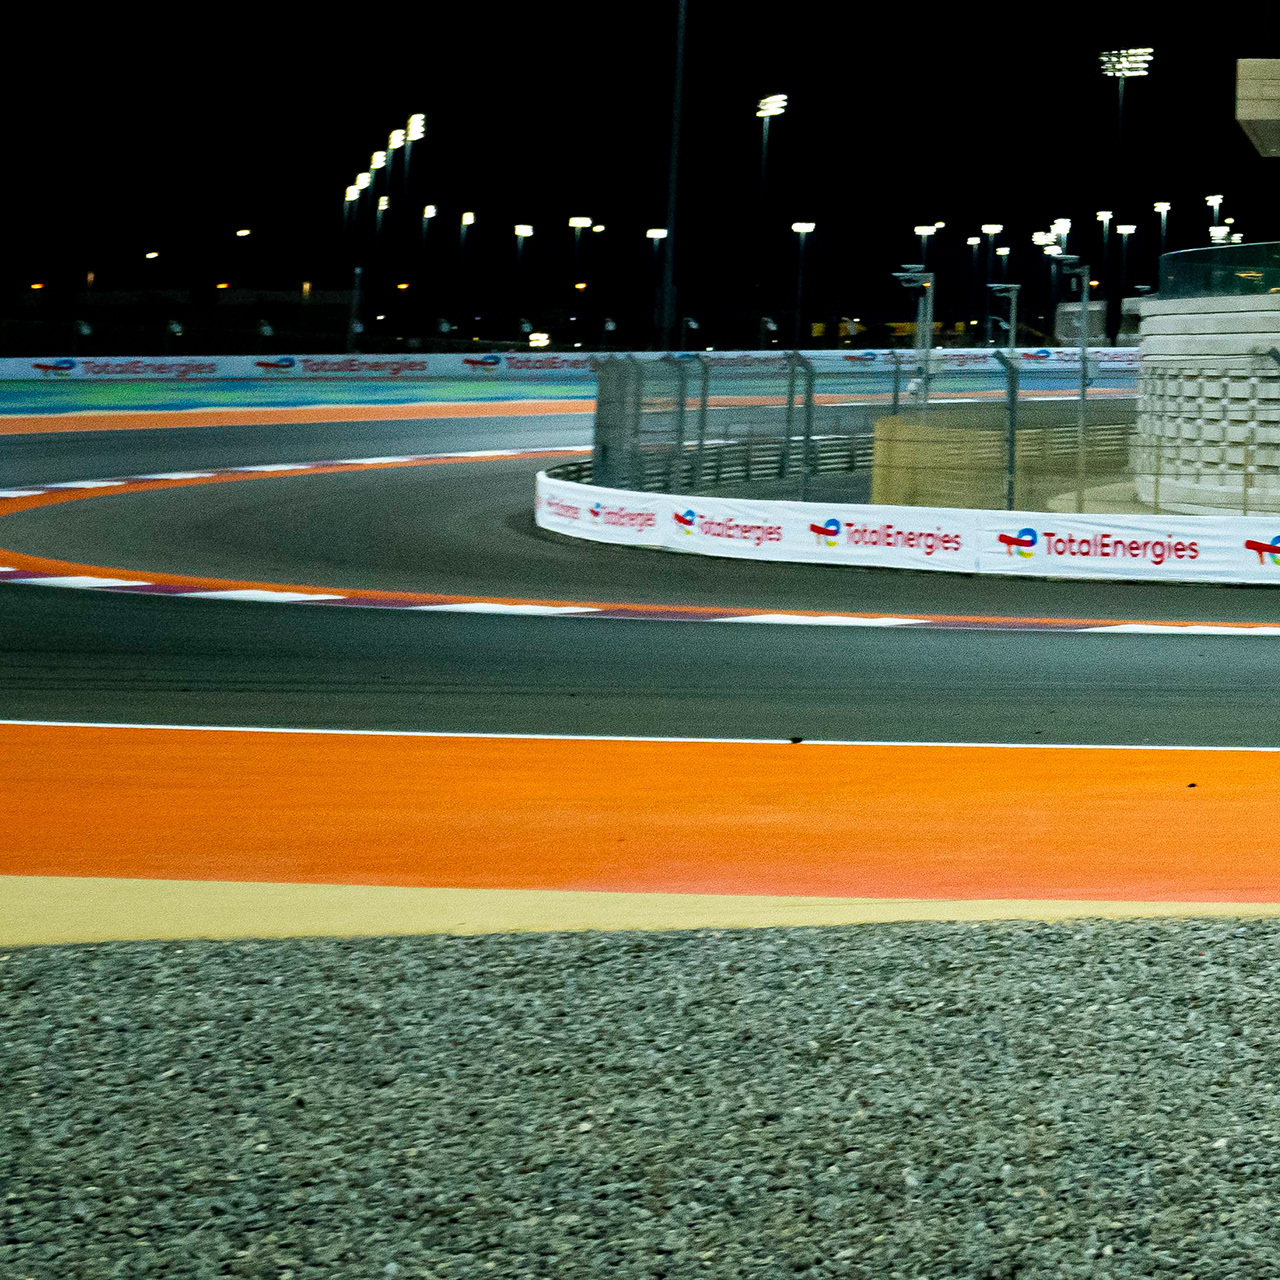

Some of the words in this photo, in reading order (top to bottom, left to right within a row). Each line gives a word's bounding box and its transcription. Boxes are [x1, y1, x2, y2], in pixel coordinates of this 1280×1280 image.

[697, 514, 782, 546] TotalEnergies
[844, 522, 962, 556] TotalEnergies
[1042, 532, 1200, 566] TotalEnergies
